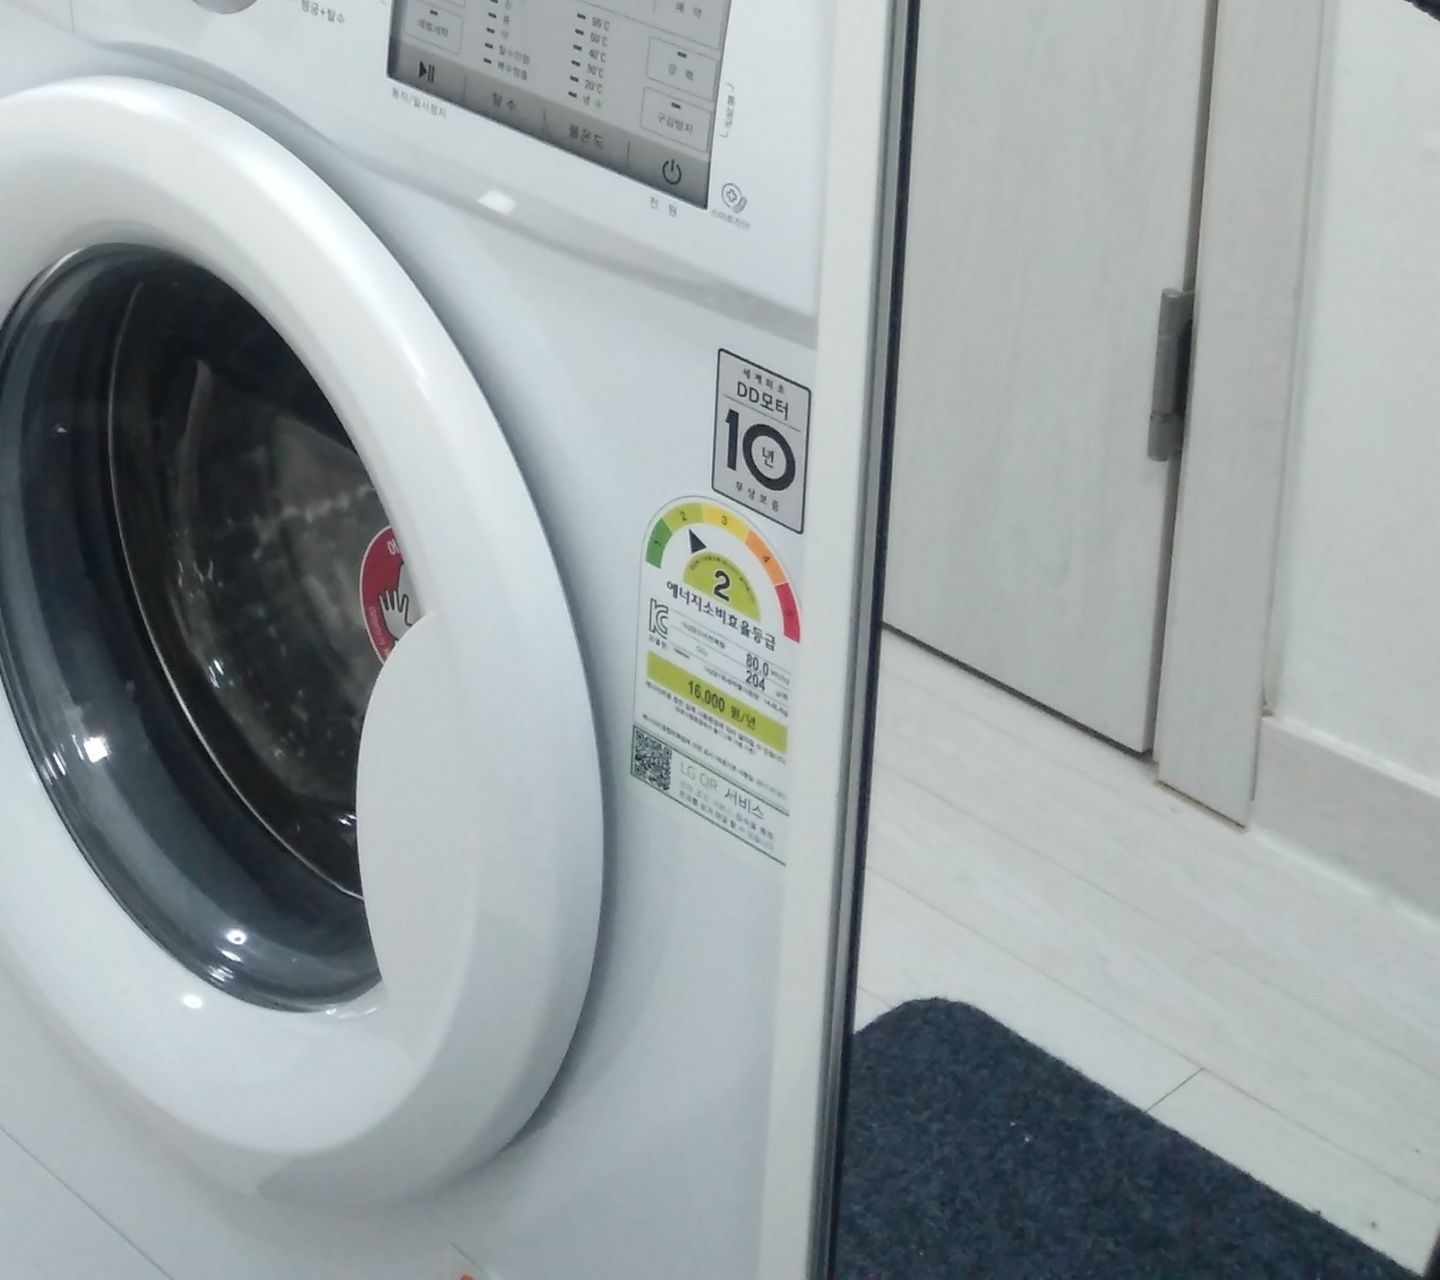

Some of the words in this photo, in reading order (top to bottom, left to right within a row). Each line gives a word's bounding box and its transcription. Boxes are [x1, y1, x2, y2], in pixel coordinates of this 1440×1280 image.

[736, 381, 789, 421] DD모터
[725, 408, 796, 491] 10
[762, 446, 775, 469] 년
[680, 511, 687, 522] 2
[721, 515, 728, 526] 3
[713, 570, 731, 602] 2
[666, 581, 776, 651] 에너지소비효율등급
[745, 670, 766, 691] 204
[746, 653, 770, 677] 80.0
[688, 680, 726, 713] 16,000
[724, 788, 765, 820] 서비스
